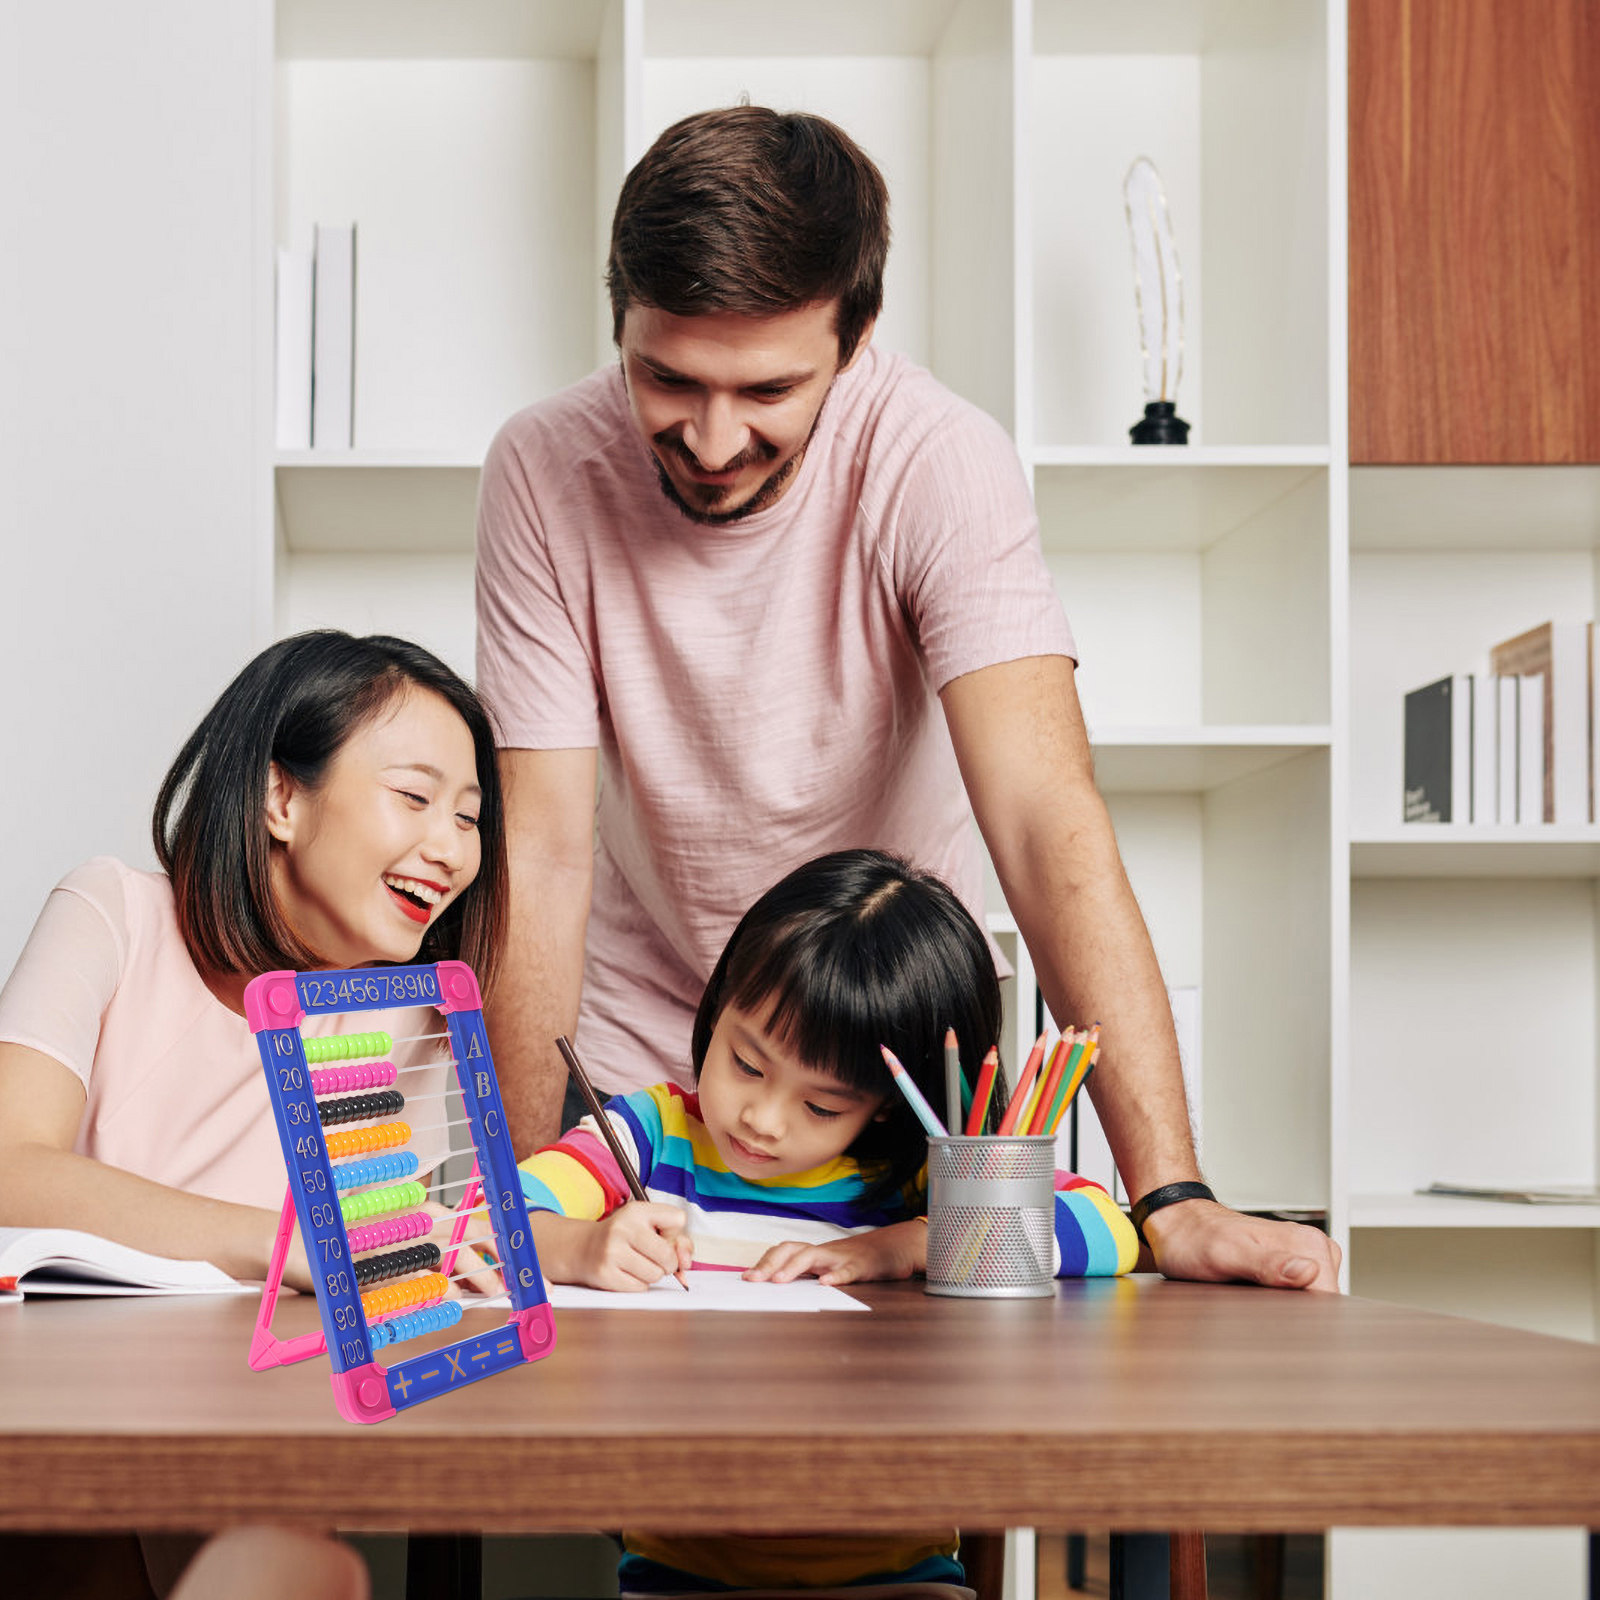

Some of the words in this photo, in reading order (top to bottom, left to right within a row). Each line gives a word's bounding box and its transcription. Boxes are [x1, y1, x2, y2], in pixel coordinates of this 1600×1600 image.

[300, 973, 436, 1007] 12345678910
[272, 1033, 294, 1057] 10
[466, 1032, 483, 1059] A
[279, 1067, 303, 1091] 20
[476, 1071, 491, 1099] B
[287, 1102, 310, 1125] 30
[484, 1111, 500, 1137] C
[296, 1135, 318, 1158] 40
[302, 1169, 326, 1193] 50
[502, 1191, 516, 1211] a
[311, 1203, 334, 1228] 60
[318, 1237, 342, 1262] 70
[327, 1271, 350, 1296] 80
[519, 1268, 534, 1287] e
[335, 1305, 357, 1330] 90
[342, 1339, 365, 1365] 100
